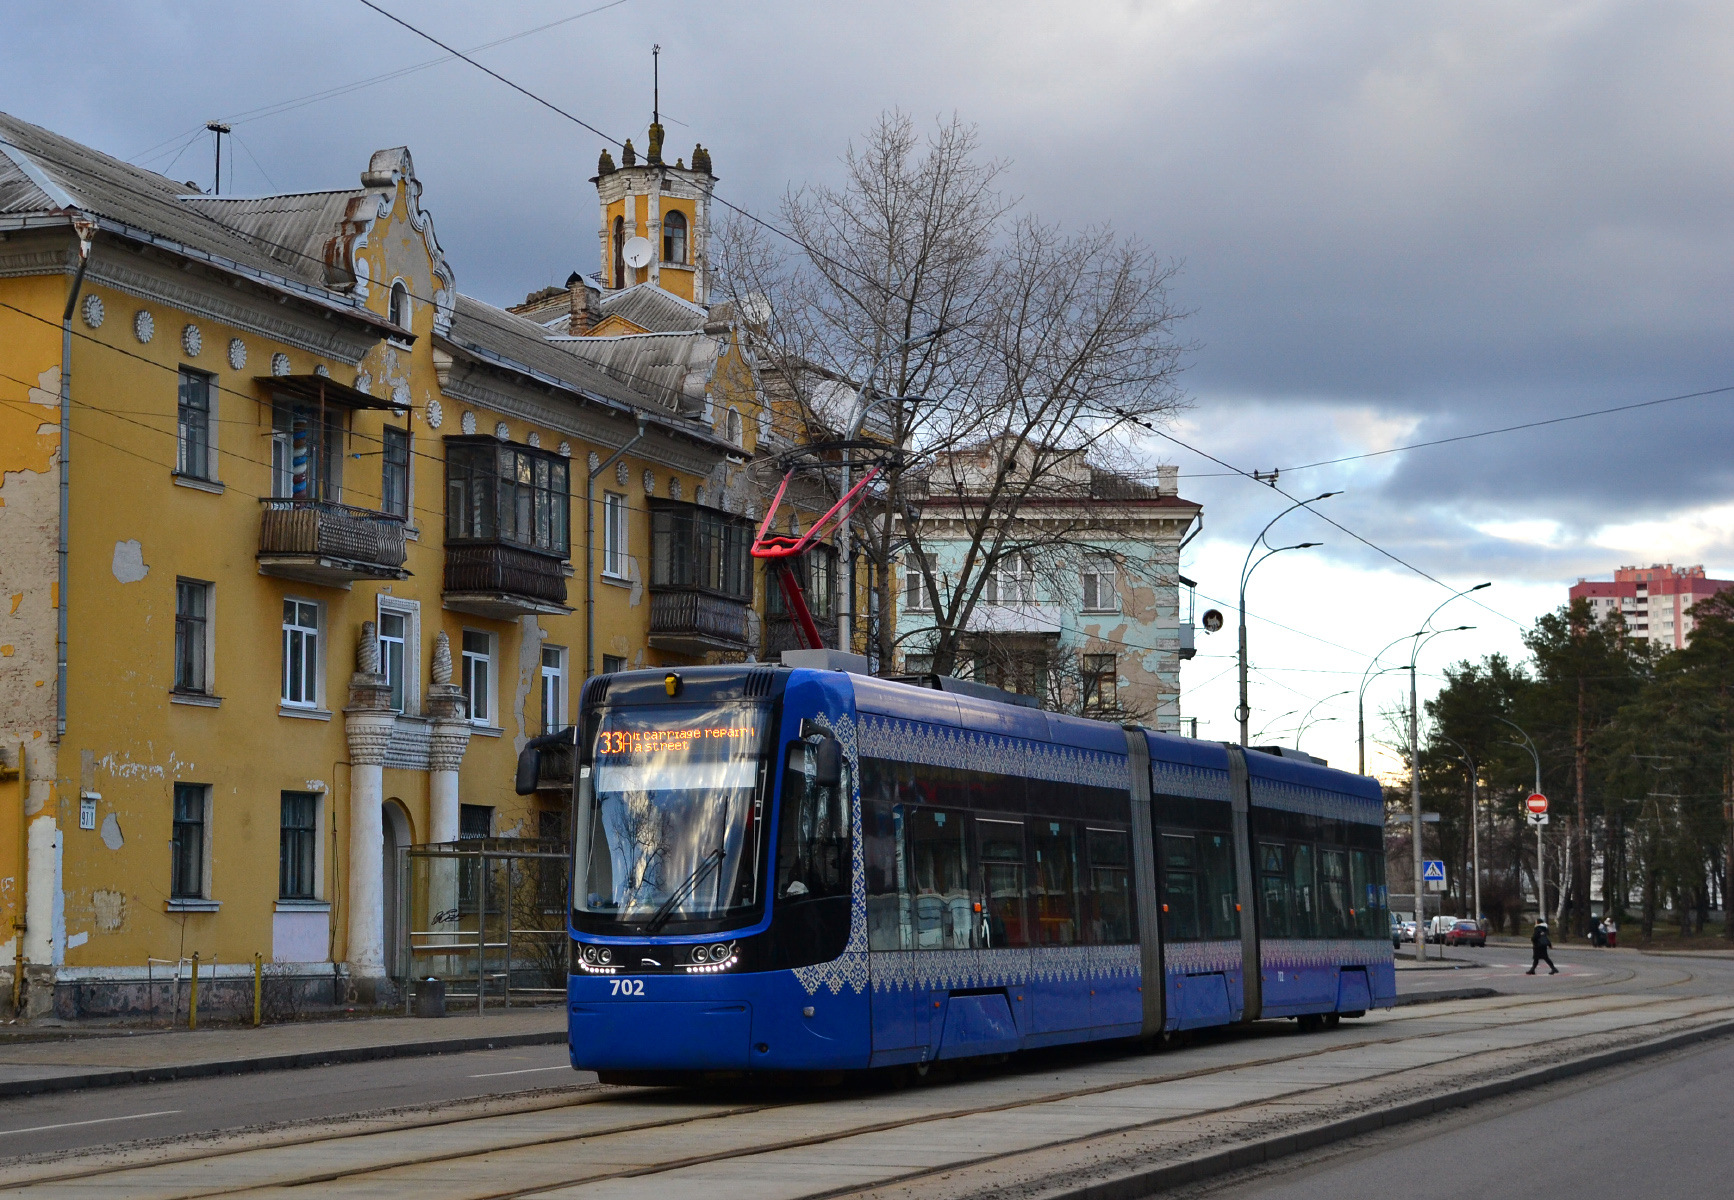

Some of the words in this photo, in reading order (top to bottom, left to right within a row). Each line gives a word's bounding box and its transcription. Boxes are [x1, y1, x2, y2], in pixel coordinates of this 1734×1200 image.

[643, 728, 701, 741] carriage
[704, 727, 748, 738] repair
[600, 731, 632, 754] 33A
[645, 740, 689, 752] street
[610, 979, 645, 996] 702
